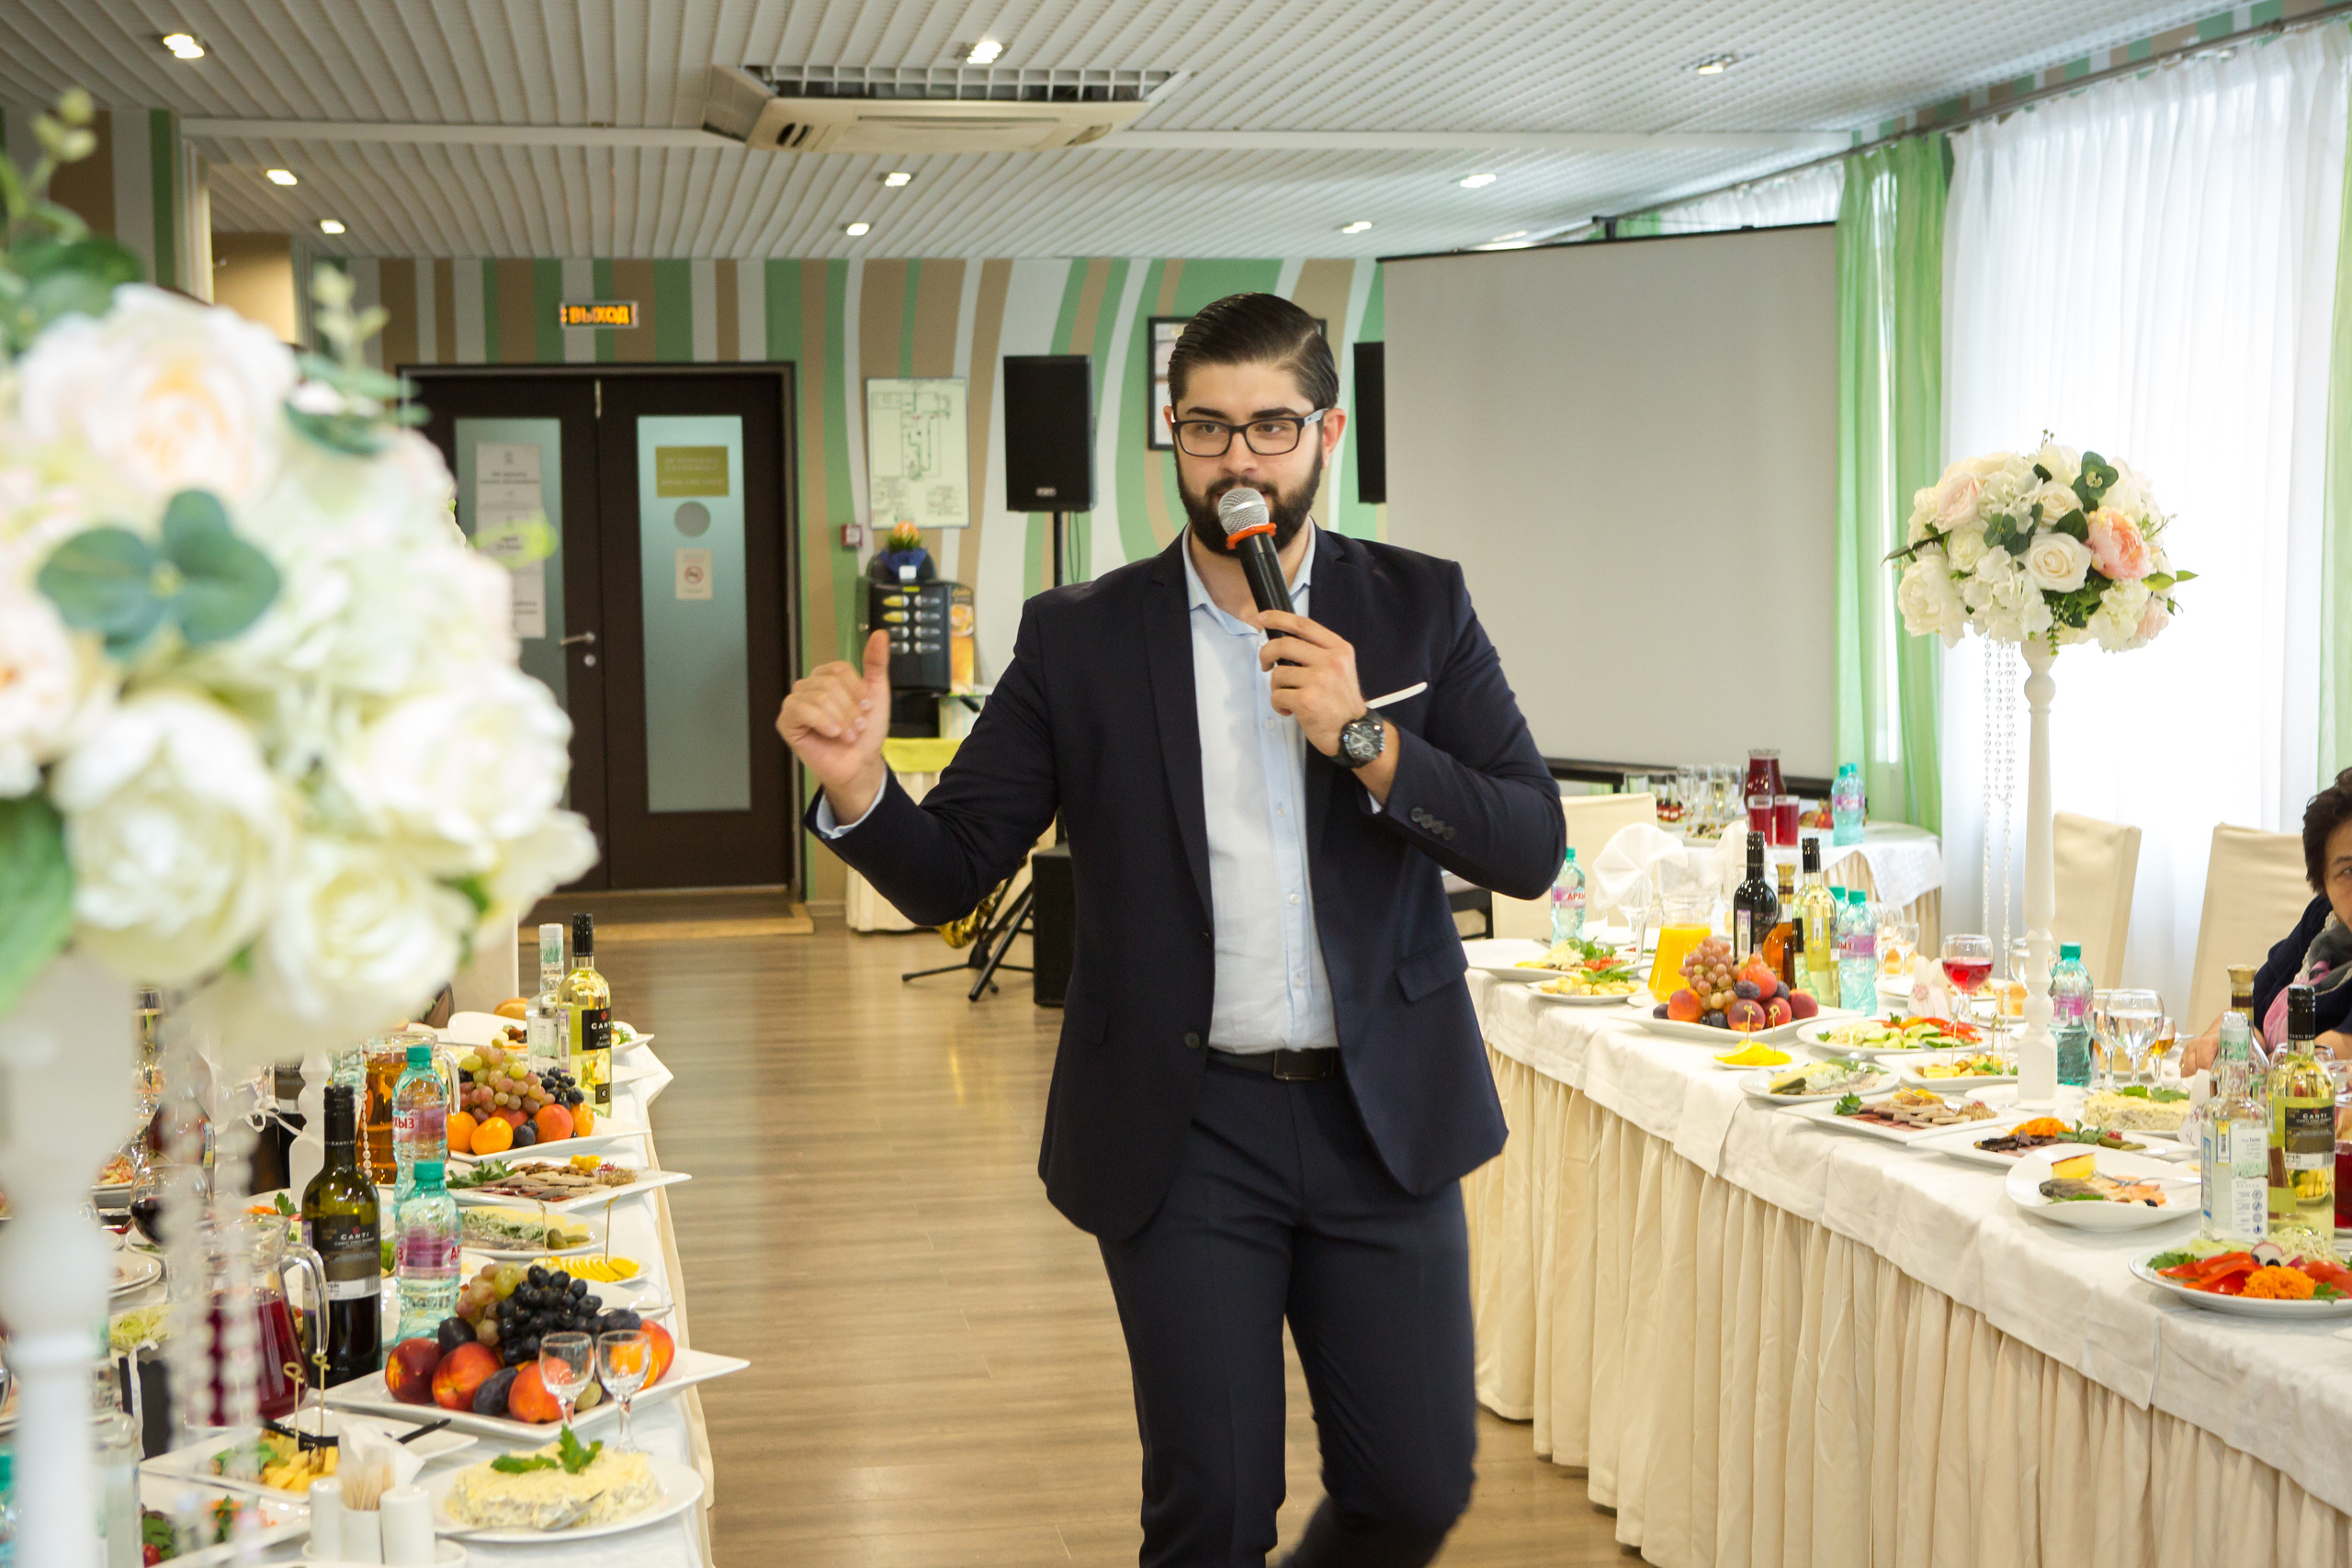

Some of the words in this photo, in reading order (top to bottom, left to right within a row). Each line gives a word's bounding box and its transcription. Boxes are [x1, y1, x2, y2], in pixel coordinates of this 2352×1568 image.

[569, 305, 630, 325] ВЫХОД
[591, 1021, 611, 1030] CANT
[2302, 1112, 2328, 1121] CANTI
[392, 1116, 415, 1130] ХЫЗ
[340, 1232, 370, 1242] CANTI
